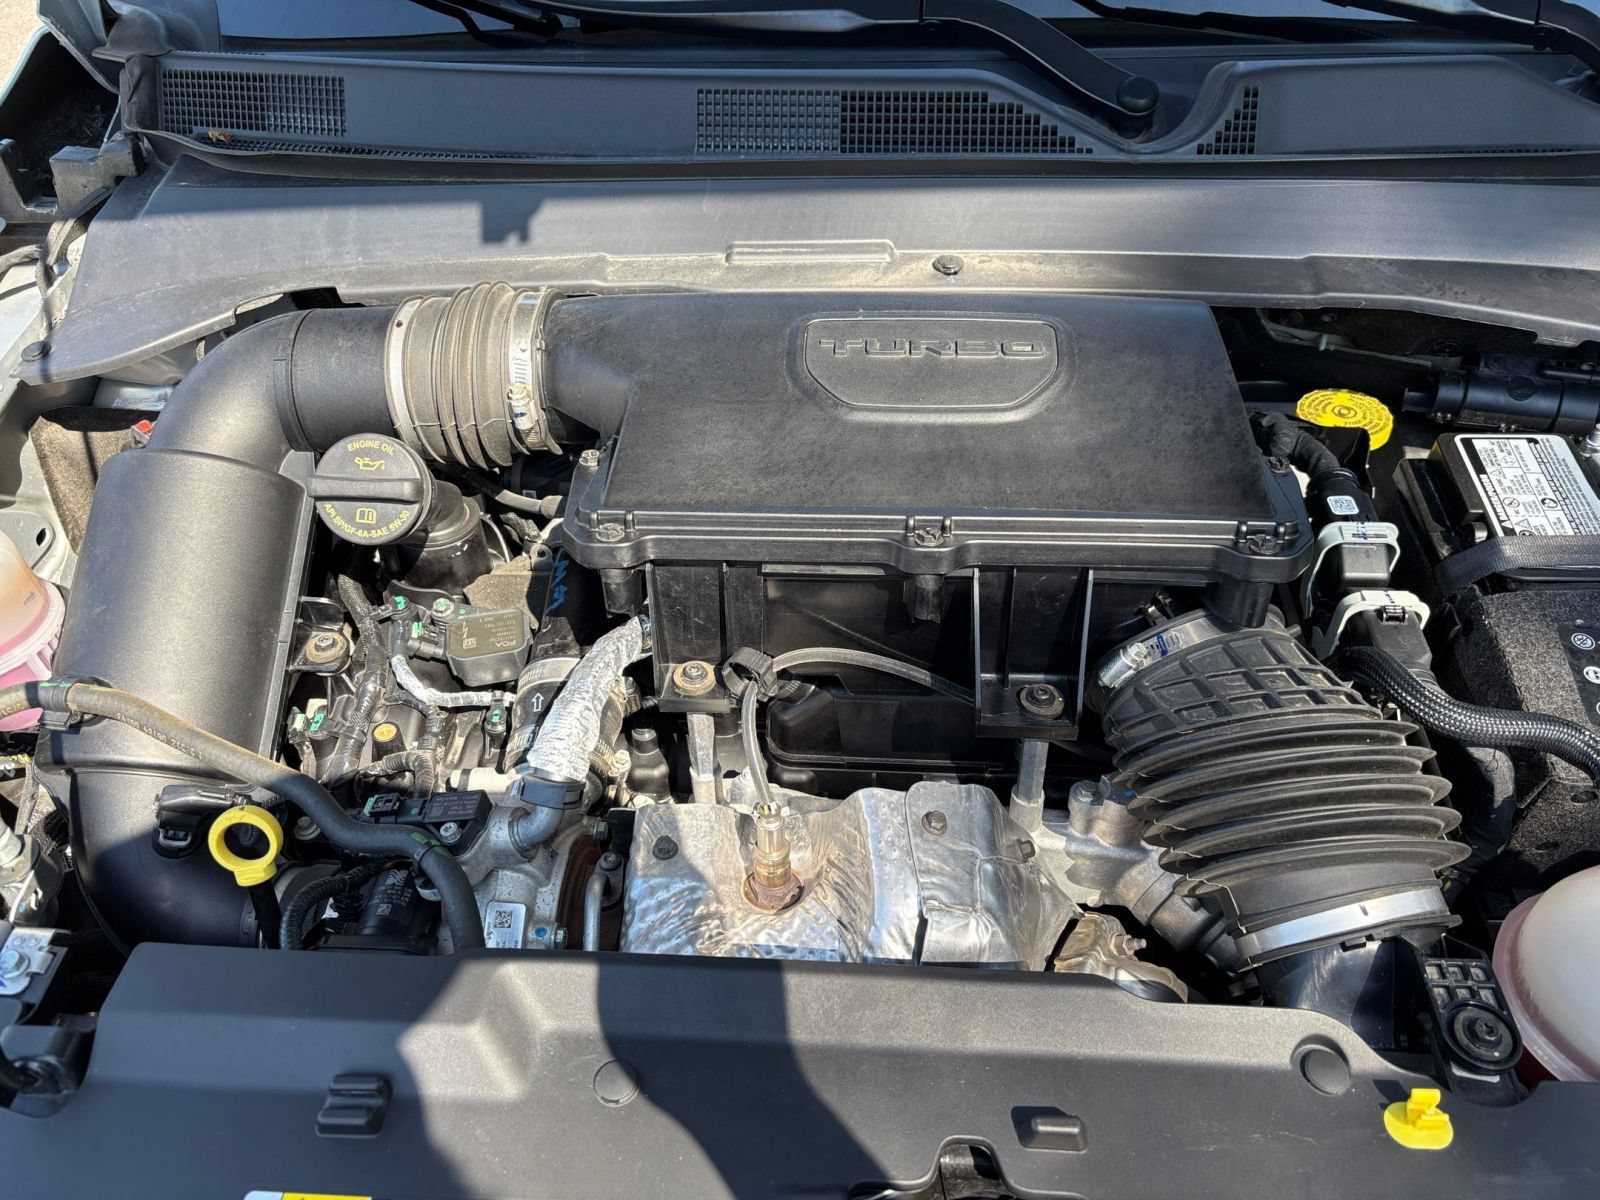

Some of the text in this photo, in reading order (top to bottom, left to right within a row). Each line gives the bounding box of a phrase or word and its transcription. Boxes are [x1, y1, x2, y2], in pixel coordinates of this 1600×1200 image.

[818, 338, 1046, 358] TURBO
[347, 441, 394, 456] ENGINE OIL
[324, 503, 336, 518] API
[389, 510, 410, 531] 5W-30
